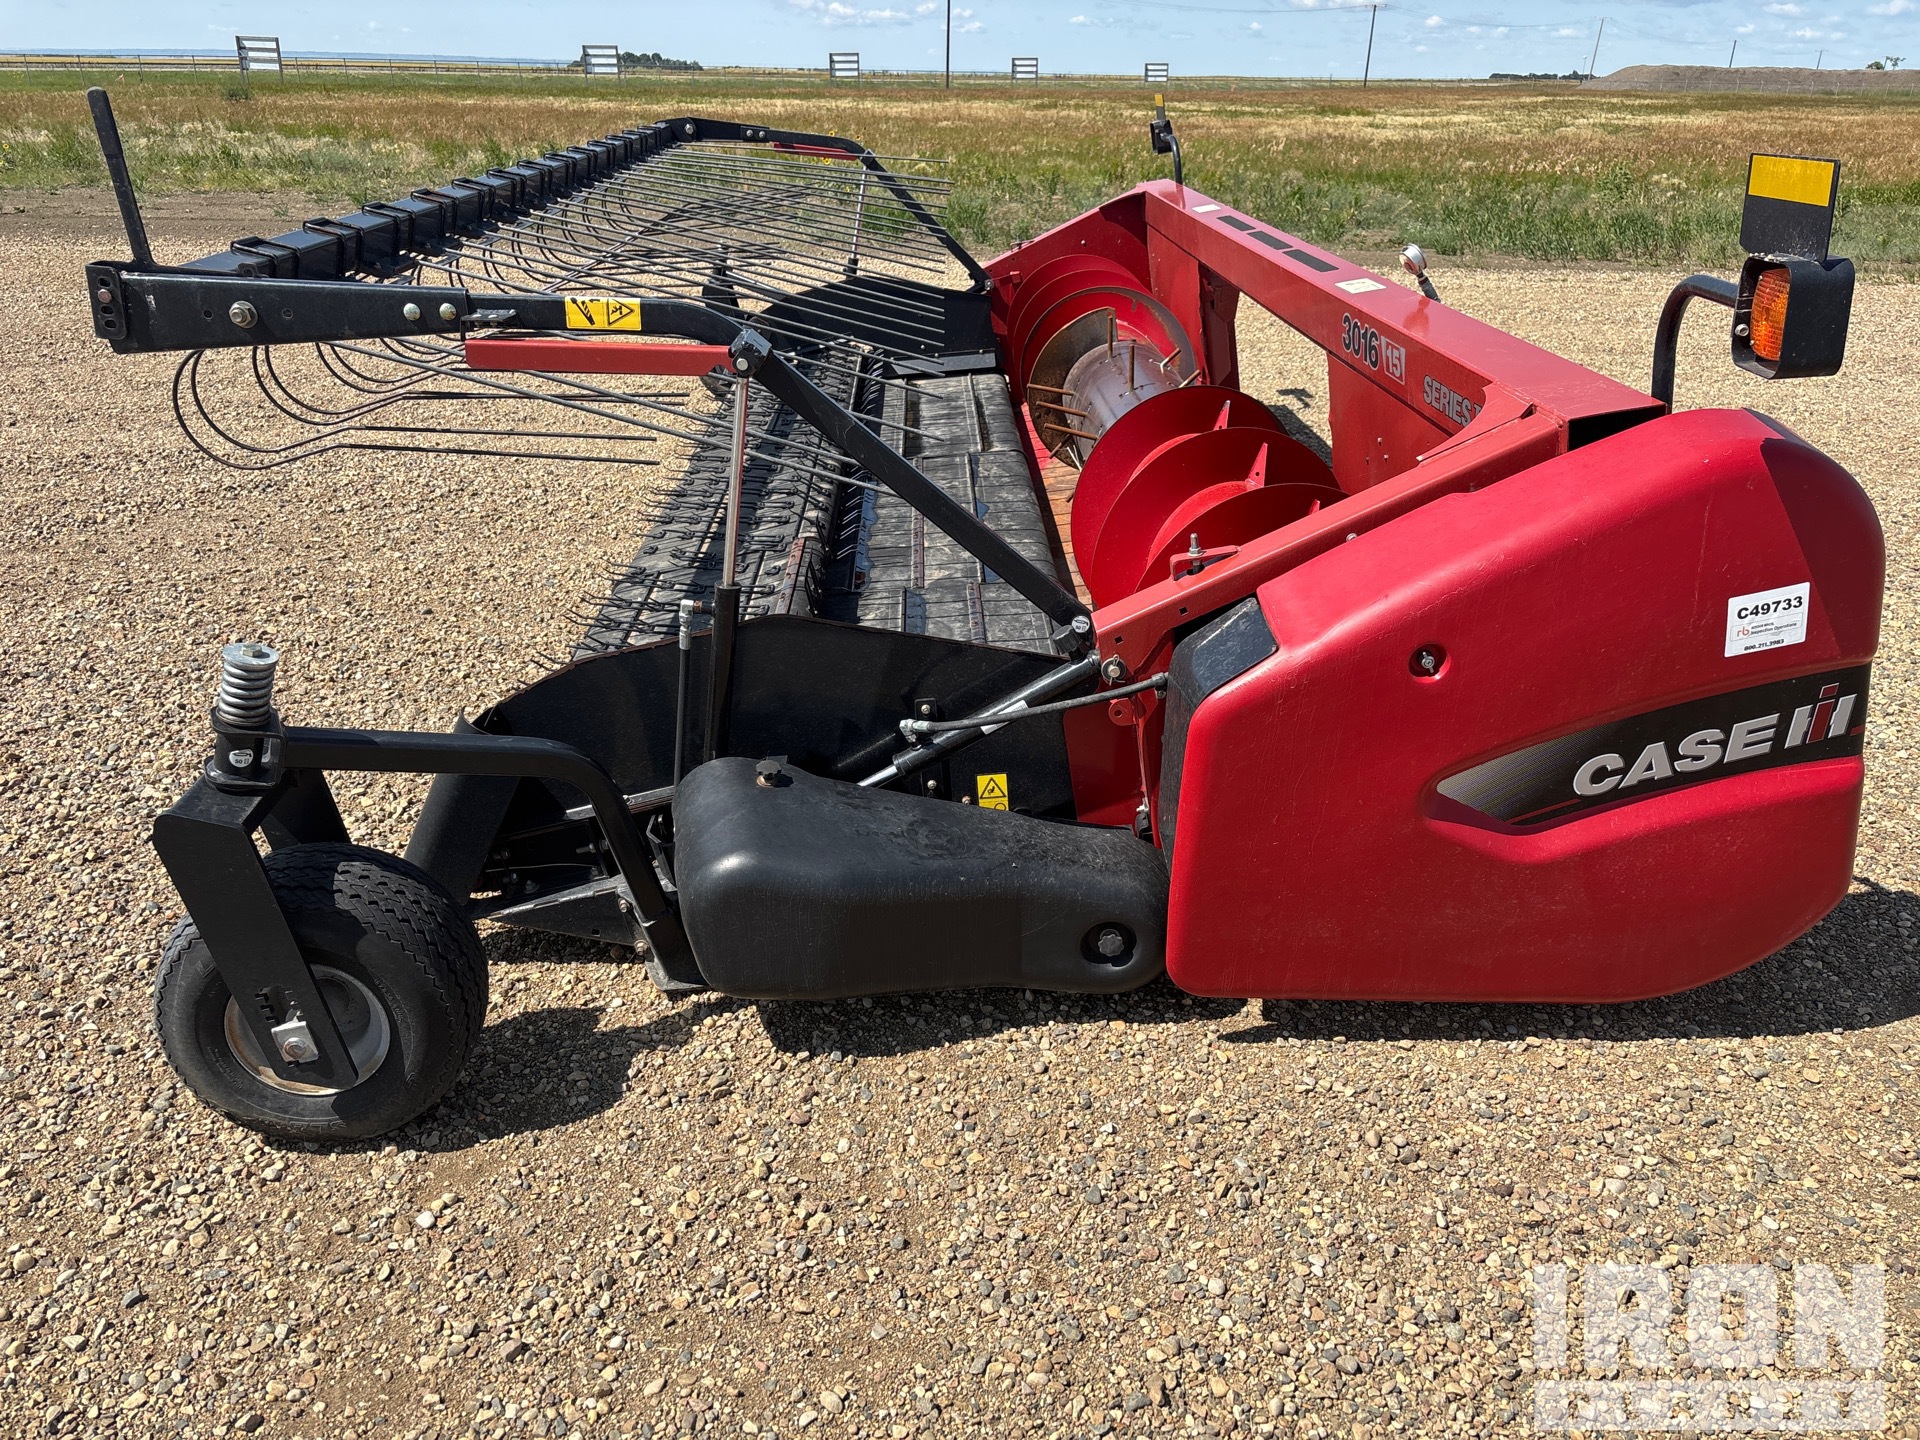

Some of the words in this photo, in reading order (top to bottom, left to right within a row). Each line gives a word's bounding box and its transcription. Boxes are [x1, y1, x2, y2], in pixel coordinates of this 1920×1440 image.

[1342, 313, 1380, 370] 3016
[1386, 345, 1401, 378] 15
[1423, 374, 1472, 427] SERIES
[1737, 596, 1803, 620] C49733
[1573, 713, 1780, 796] CASE
